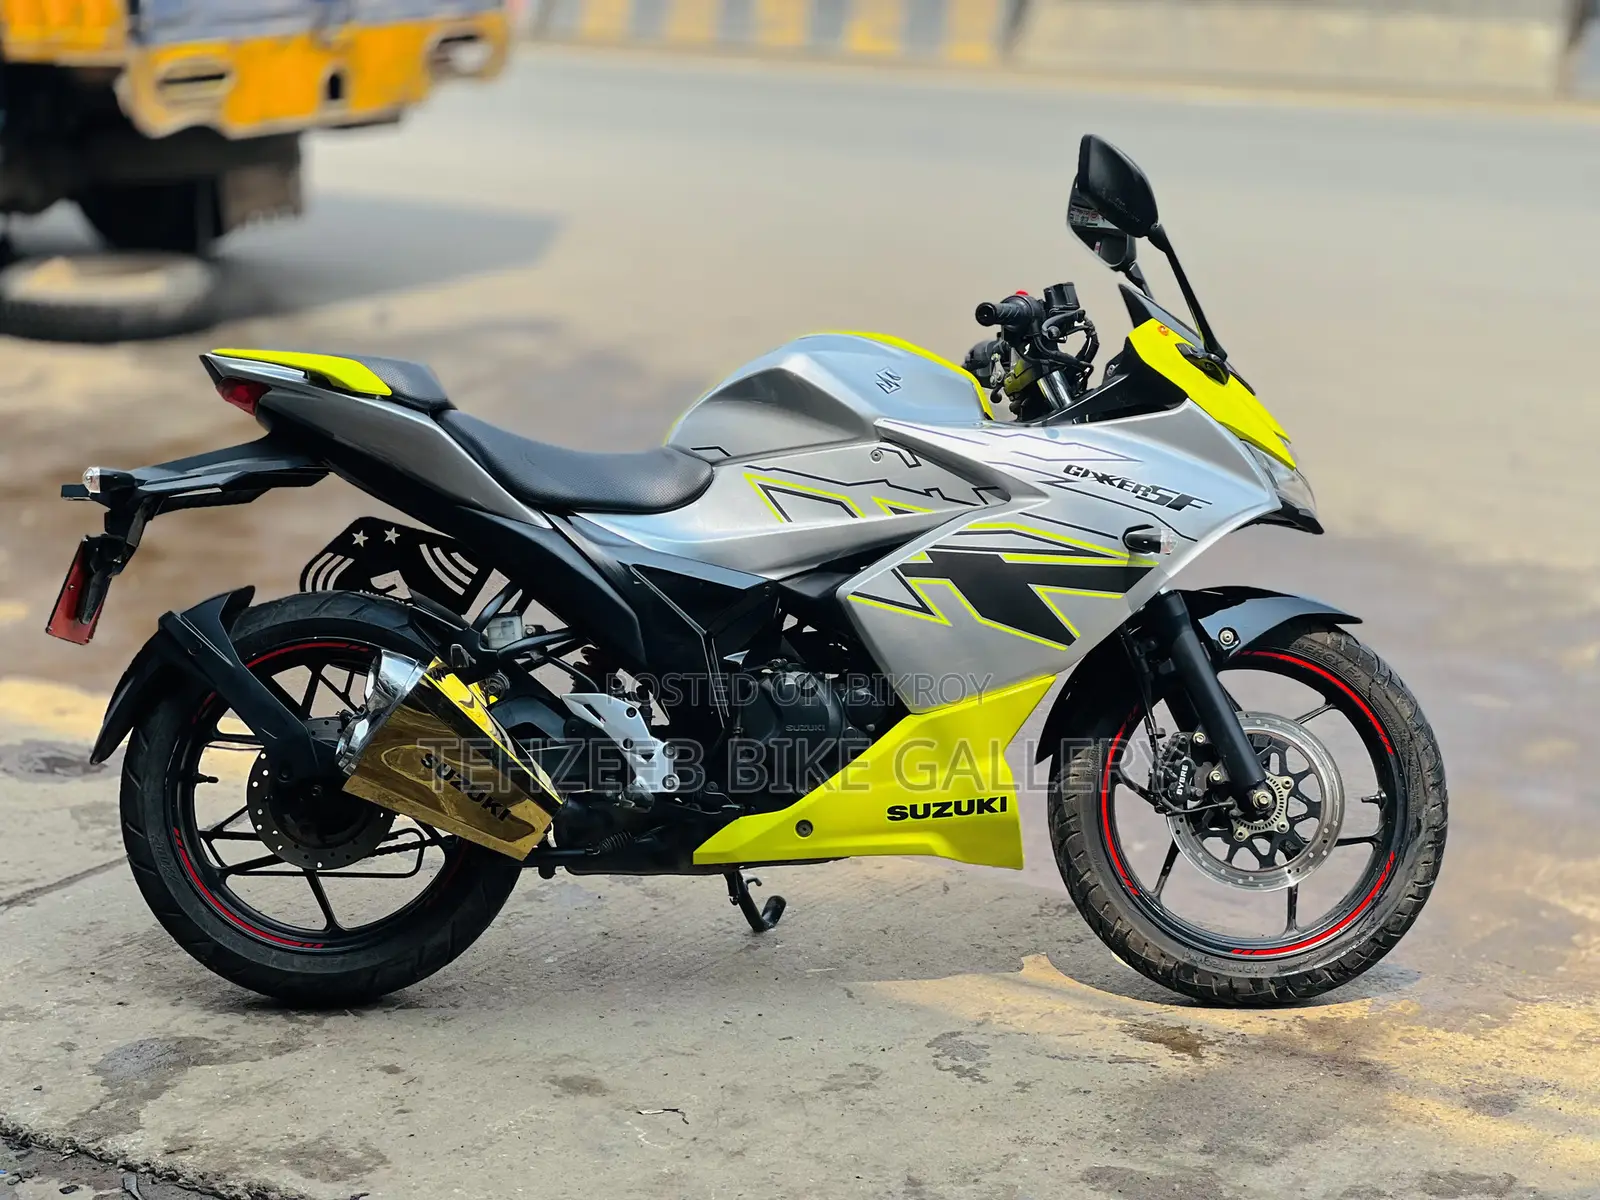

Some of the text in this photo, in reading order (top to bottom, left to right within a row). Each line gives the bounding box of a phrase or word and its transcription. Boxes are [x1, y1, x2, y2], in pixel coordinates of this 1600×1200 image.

[1135, 484, 1213, 512] SF
[785, 724, 826, 732] SUZUKI
[420, 752, 512, 822] SUZUKI
[886, 795, 1008, 822] SUZUKI
